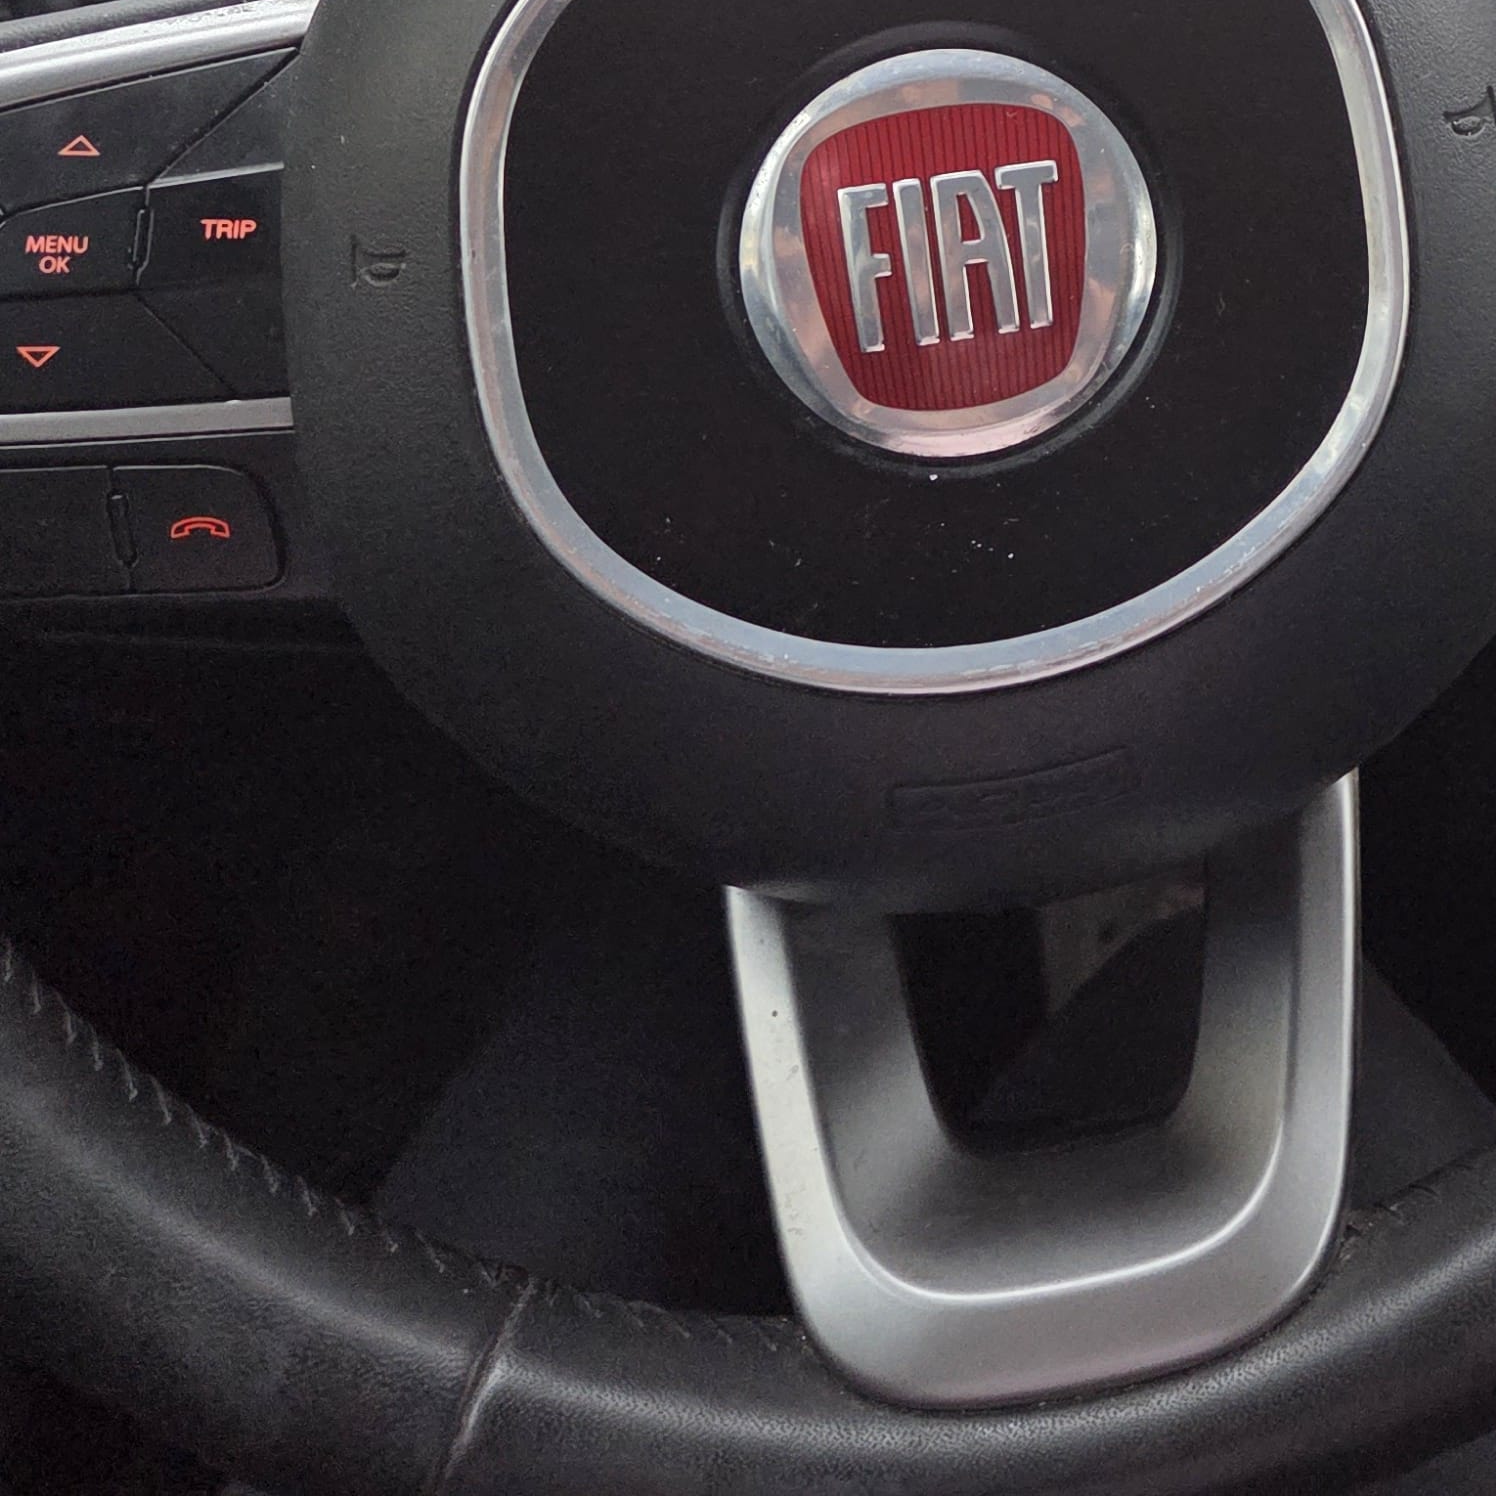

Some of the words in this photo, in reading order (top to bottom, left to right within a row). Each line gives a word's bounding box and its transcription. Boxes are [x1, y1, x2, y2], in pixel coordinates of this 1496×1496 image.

[200, 218, 257, 240] TRIP
[25, 235, 89, 254] MENU
[38, 255, 71, 274] OK
[837, 159, 1059, 353] FIAT
